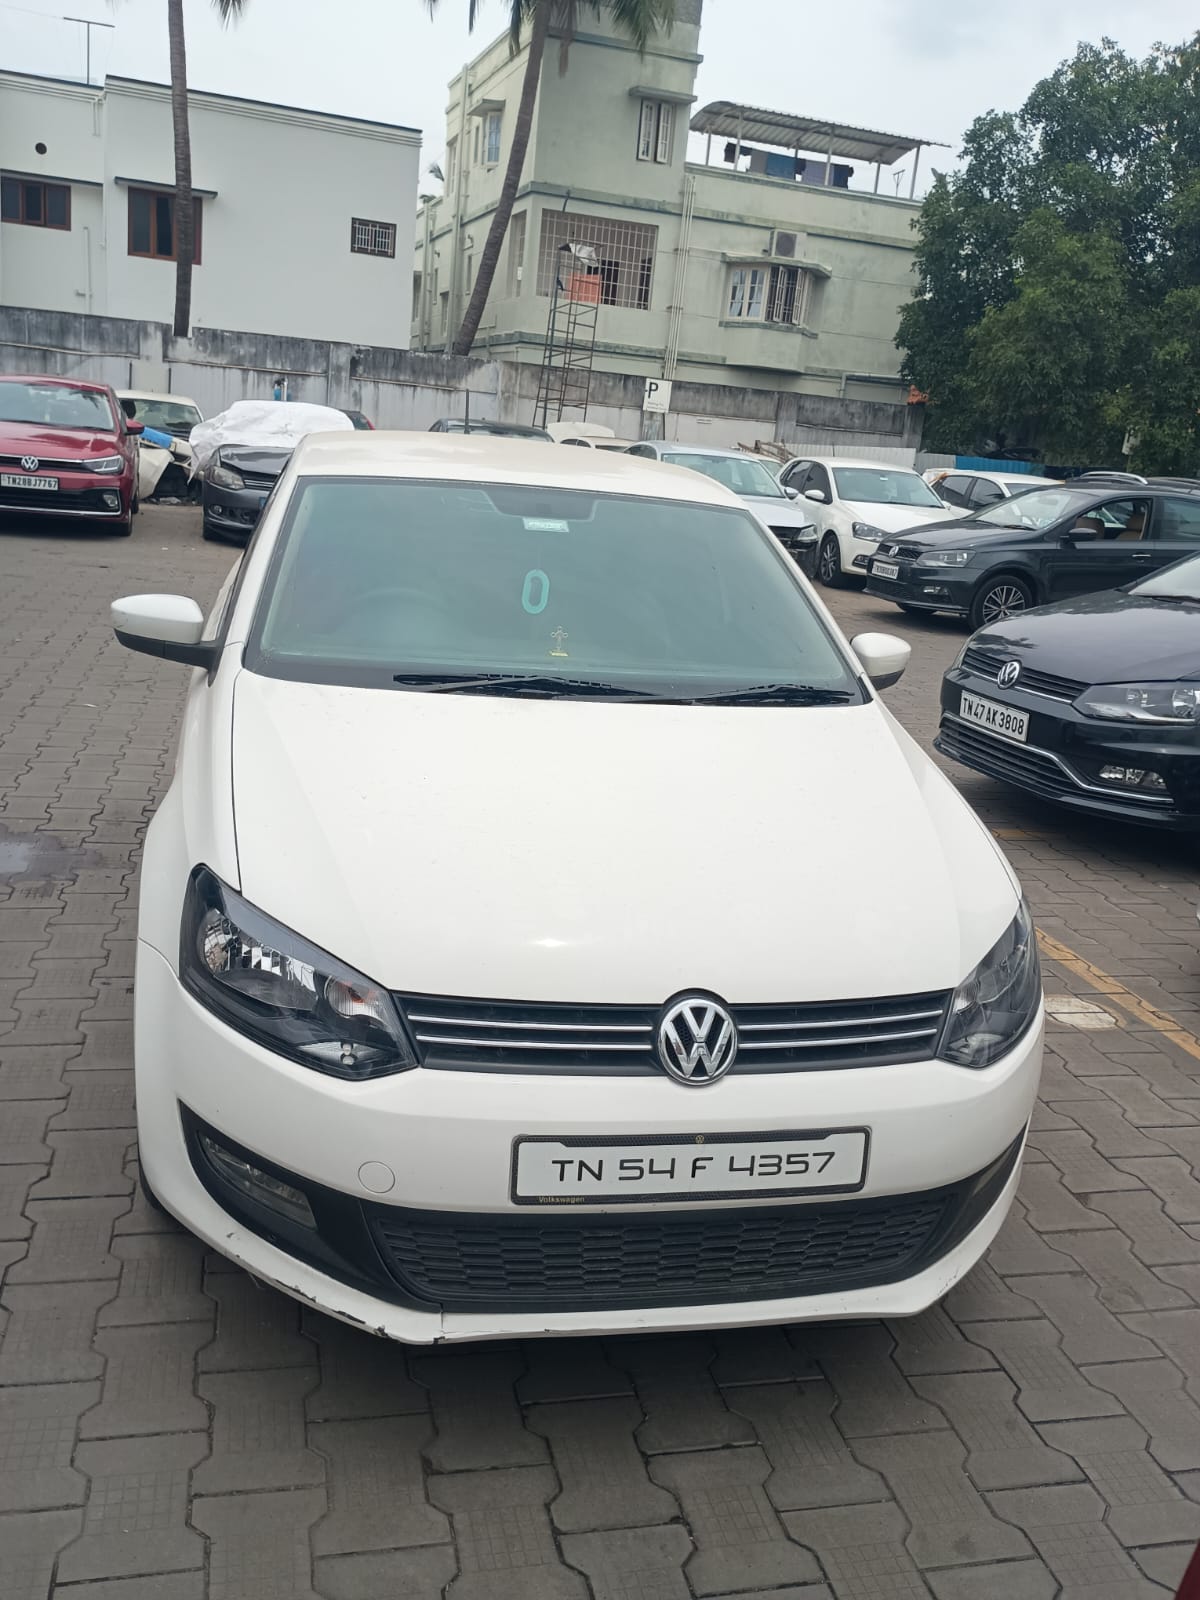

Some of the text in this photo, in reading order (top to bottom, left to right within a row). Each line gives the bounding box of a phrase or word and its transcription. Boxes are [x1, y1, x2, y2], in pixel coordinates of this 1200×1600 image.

[648, 382, 658, 399] P
[963, 698, 1024, 734] TN 47 AK 3808
[659, 1001, 736, 1083] VW
[552, 1151, 835, 1181] TN 54 F 4357
[538, 1196, 585, 1204] Volkswagen
